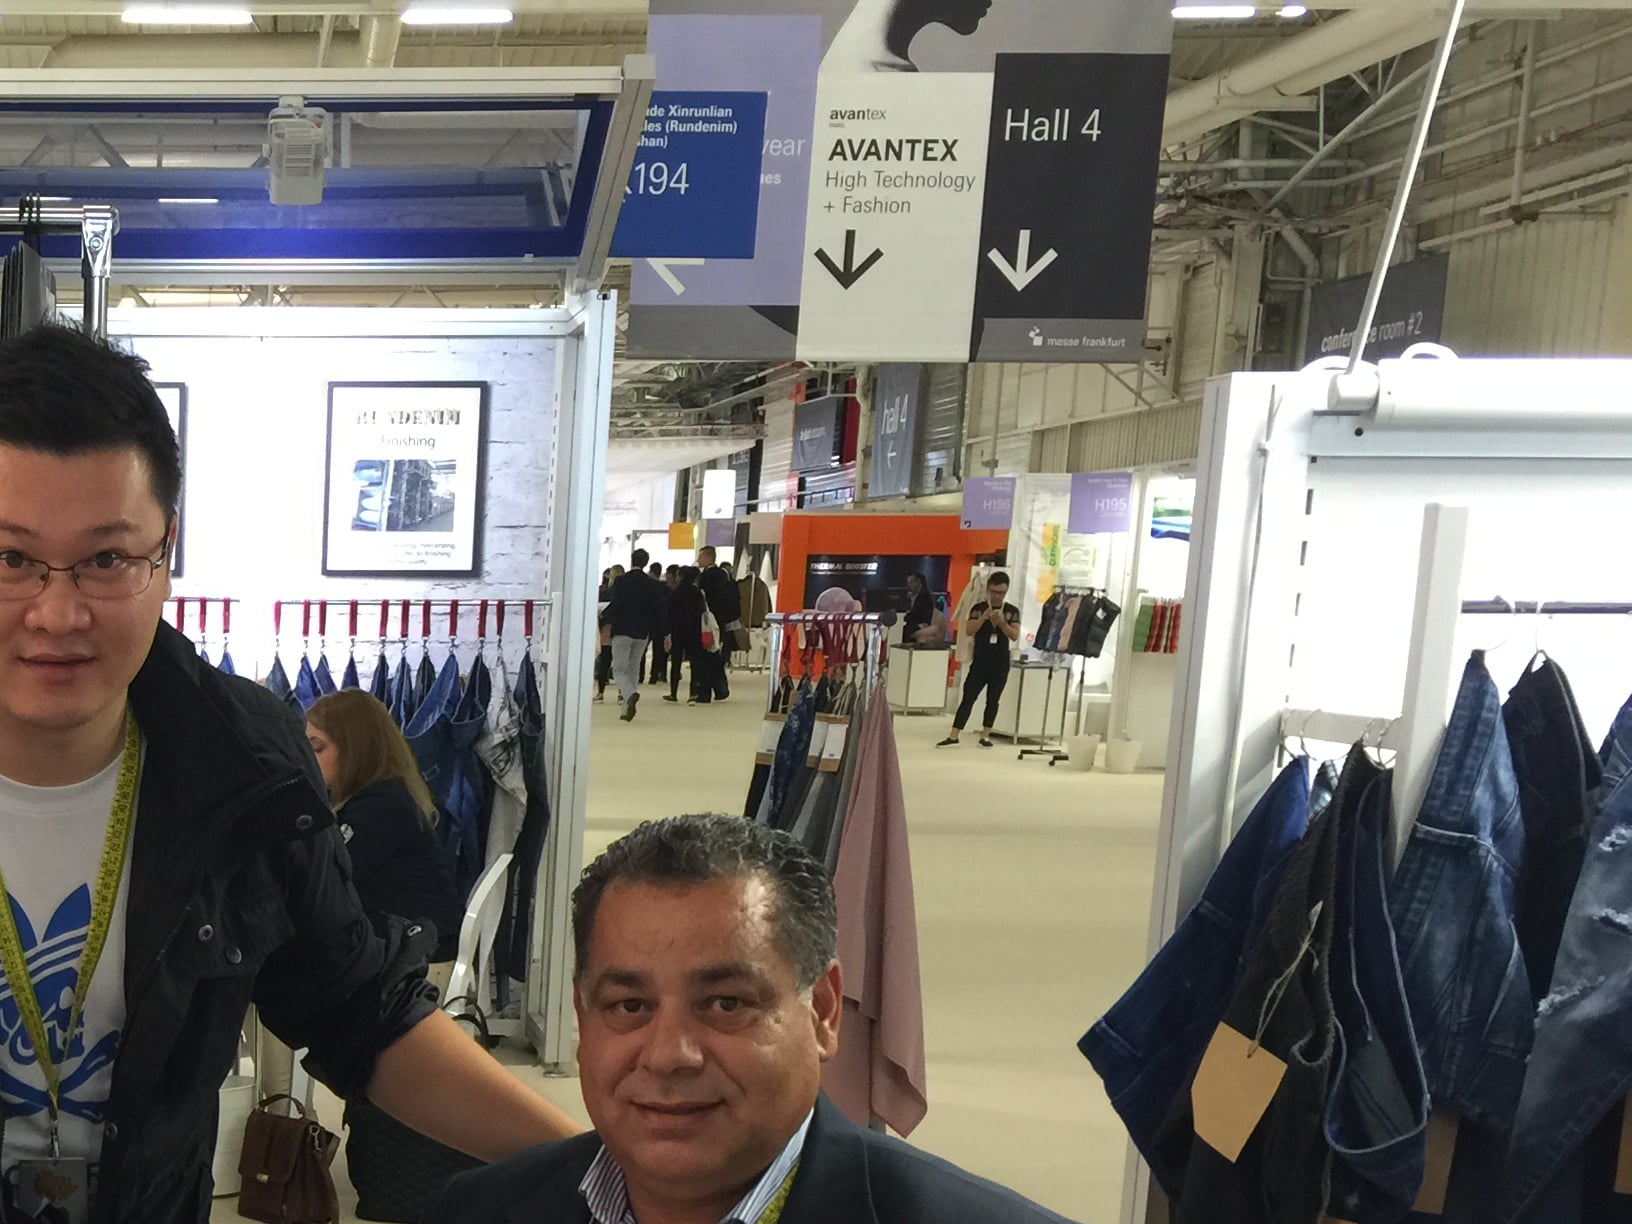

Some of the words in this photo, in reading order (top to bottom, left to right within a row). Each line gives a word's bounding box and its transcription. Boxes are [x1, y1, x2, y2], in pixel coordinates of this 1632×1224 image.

[668, 104, 733, 118] Xinrunlian
[829, 108, 887, 121] avantex
[641, 120, 662, 132] les
[665, 120, 738, 134] (Rundenim)
[1003, 108, 1071, 142] Hall
[1080, 108, 1102, 142] 4
[828, 138, 959, 162] AVANTEX
[825, 170, 868, 192] High
[874, 170, 977, 193] Technology
[823, 201, 835, 213] +
[842, 195, 912, 214] Fashion
[1321, 325, 1378, 353] conferce
[1379, 319, 1406, 341] room
[1406, 310, 1424, 336] #2
[1047, 336, 1081, 347] messe
[1082, 335, 1126, 348] frankfurt
[900, 393, 909, 431] 4
[1094, 497, 1127, 512] H195
